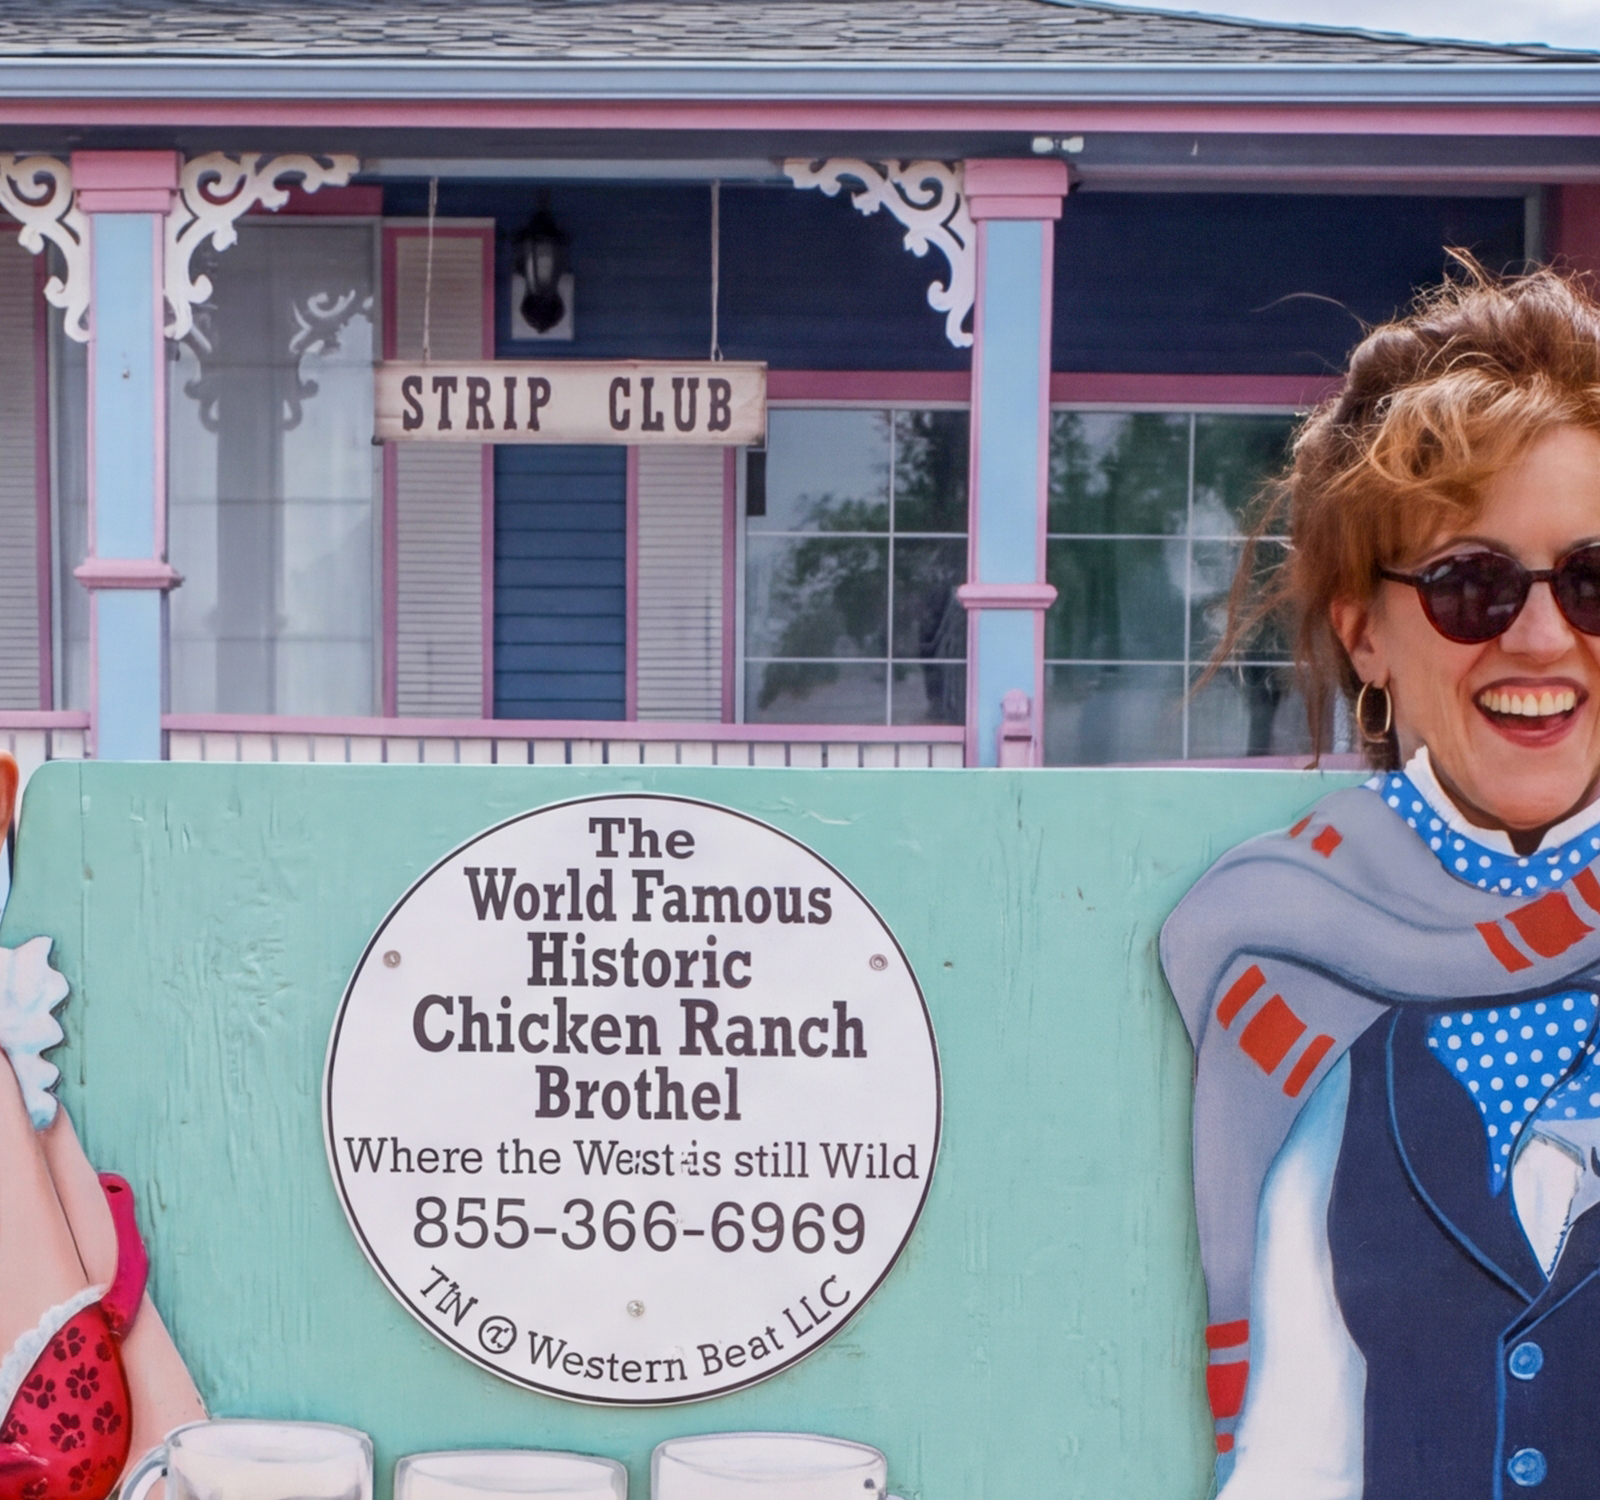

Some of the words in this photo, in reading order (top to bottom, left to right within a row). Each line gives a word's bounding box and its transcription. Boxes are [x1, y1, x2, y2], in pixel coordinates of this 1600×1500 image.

[401, 375, 552, 432] STRIP
[608, 376, 733, 433] CLUB
[588, 816, 697, 860] The
[463, 866, 618, 922] World
[631, 868, 833, 925] Famous
[526, 930, 754, 989] Historic
[412, 993, 662, 1056] Chicken
[678, 997, 869, 1058] Ranch
[534, 1064, 743, 1122] Brothel
[343, 1136, 484, 1175] Where
[496, 1138, 562, 1175] the
[572, 1139, 676, 1177] West
[684, 1139, 722, 1178] is
[733, 1141, 810, 1178] still
[818, 1142, 920, 1180] Wild
[412, 1195, 866, 1255] 855-366-6969
[527, 1330, 689, 1384] Western
[696, 1325, 785, 1377] Beat
[781, 1273, 851, 1340] LLC
